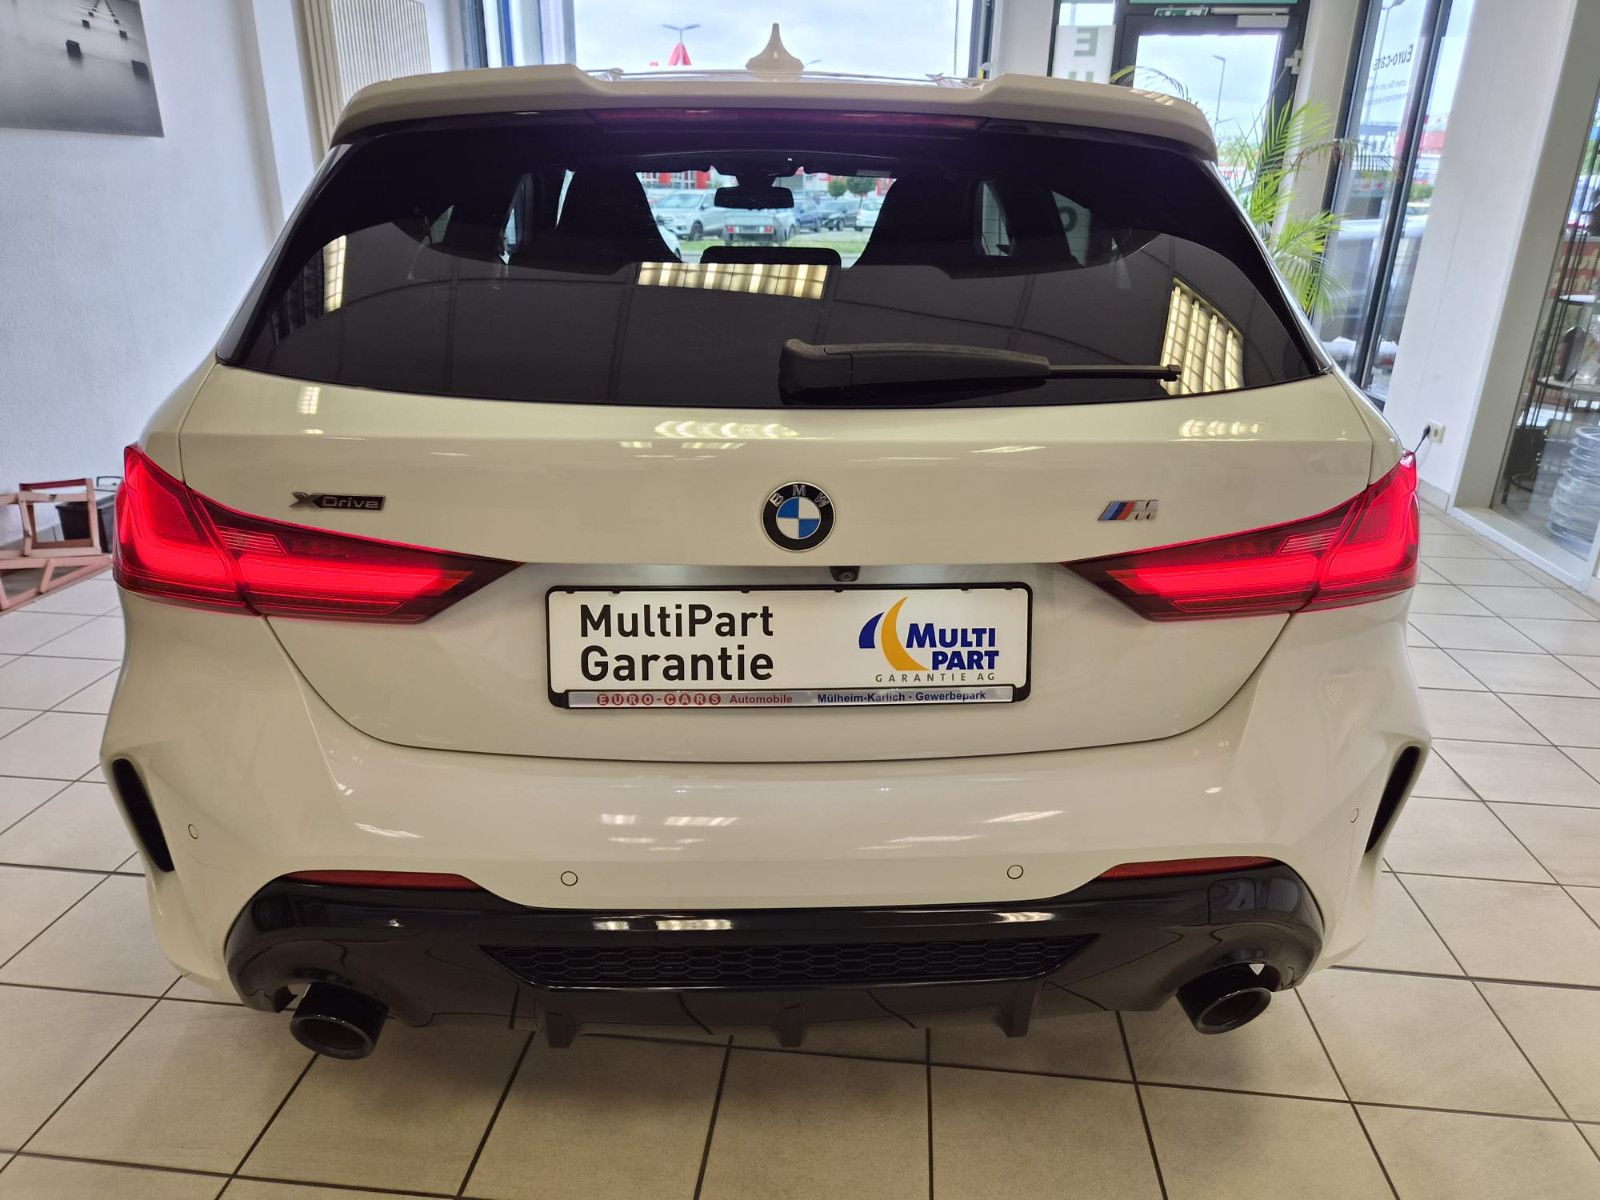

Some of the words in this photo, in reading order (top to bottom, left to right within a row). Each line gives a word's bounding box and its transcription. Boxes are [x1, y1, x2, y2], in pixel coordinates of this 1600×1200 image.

[769, 484, 829, 508] BMW
[580, 604, 774, 637] MultiPart
[905, 623, 996, 648] MULTI
[580, 644, 774, 682] Garantie
[931, 650, 999, 671] PART
[875, 673, 967, 683] GARANTIE
[976, 672, 995, 681] AG
[729, 694, 793, 704] Automobile
[915, 690, 986, 702] Gewerbepark
